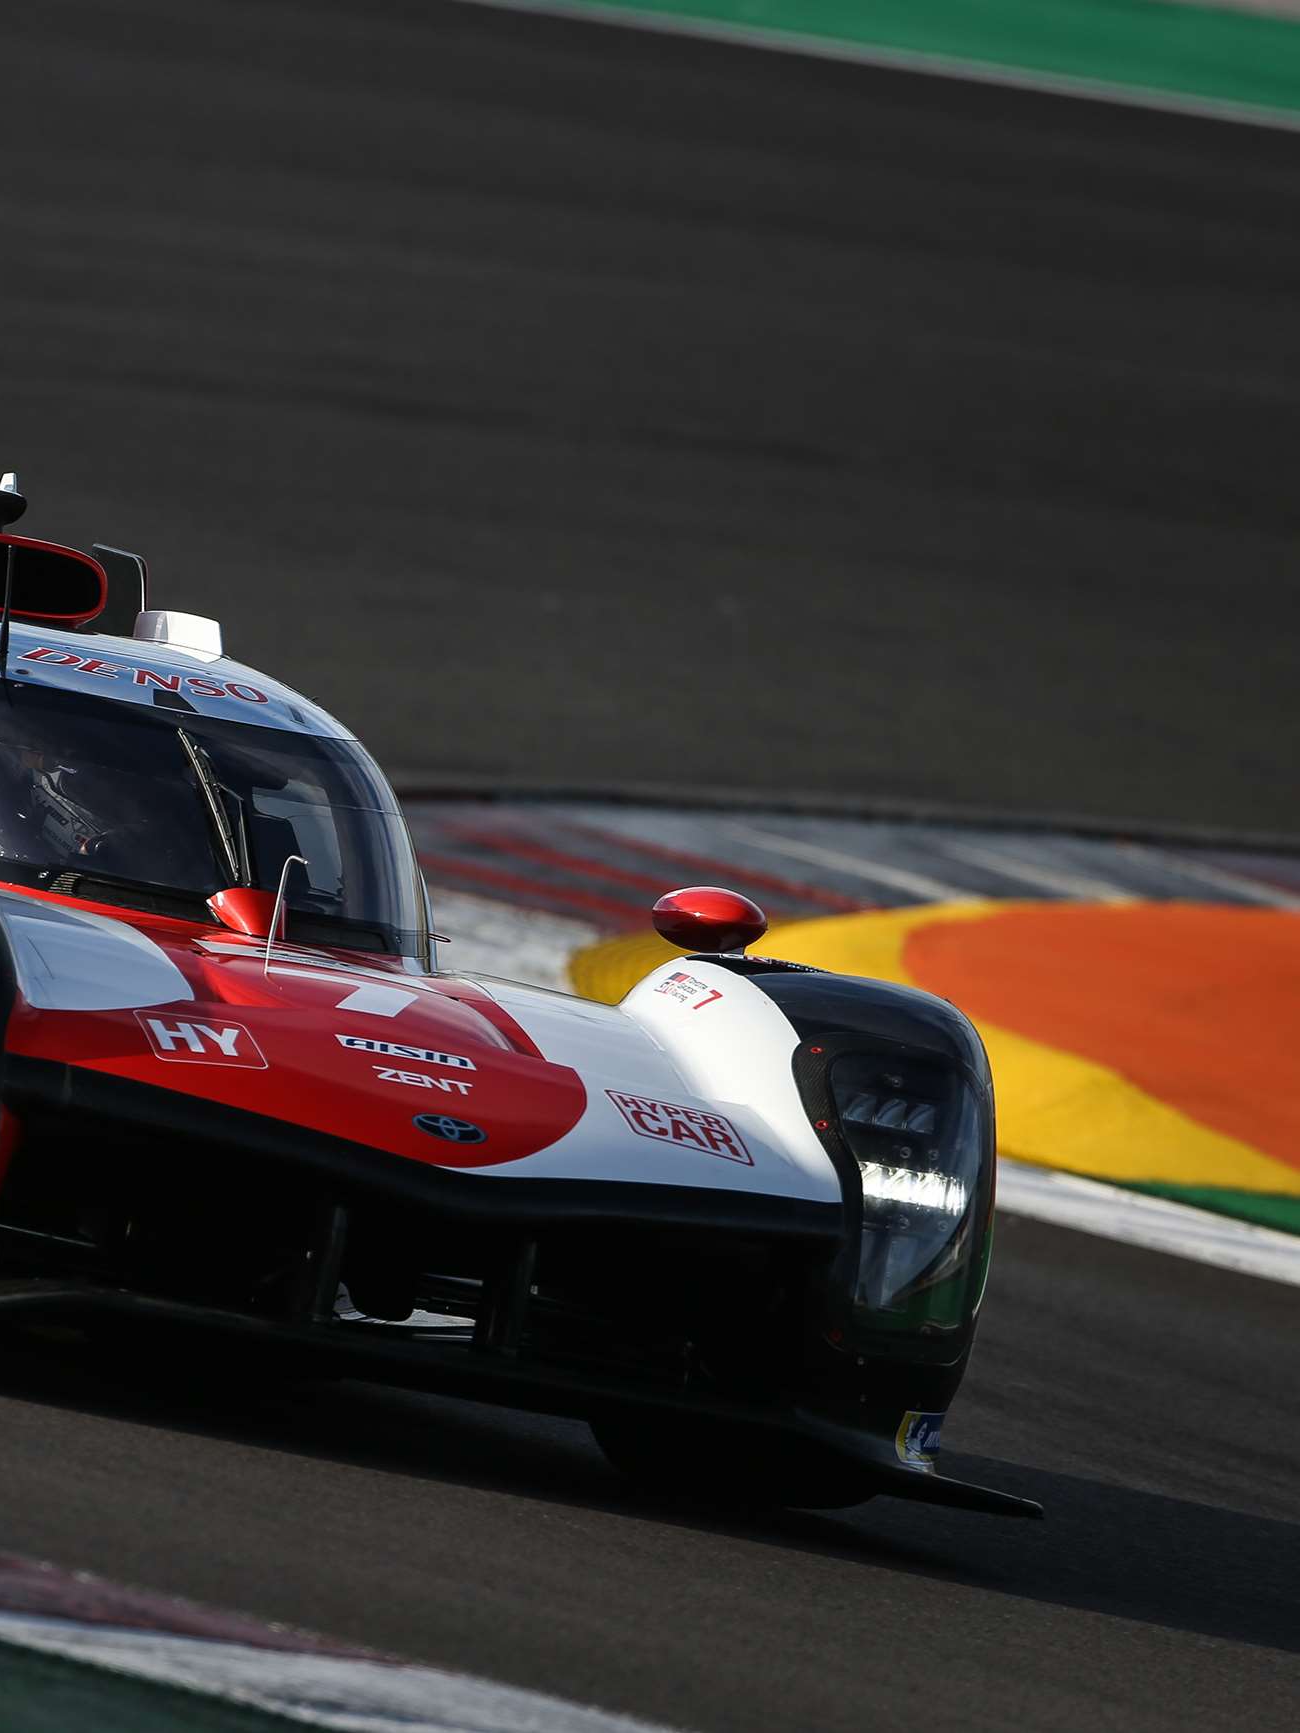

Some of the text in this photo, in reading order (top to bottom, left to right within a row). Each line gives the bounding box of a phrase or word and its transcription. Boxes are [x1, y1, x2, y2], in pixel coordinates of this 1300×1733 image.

[17, 646, 269, 705] DENSO
[692, 989, 724, 1010] 7
[146, 1018, 240, 1057] HY
[345, 1037, 469, 1068] AISIN
[371, 1065, 475, 1096] ZENT
[617, 1092, 723, 1130] HYPER
[634, 1111, 743, 1159] CAR
